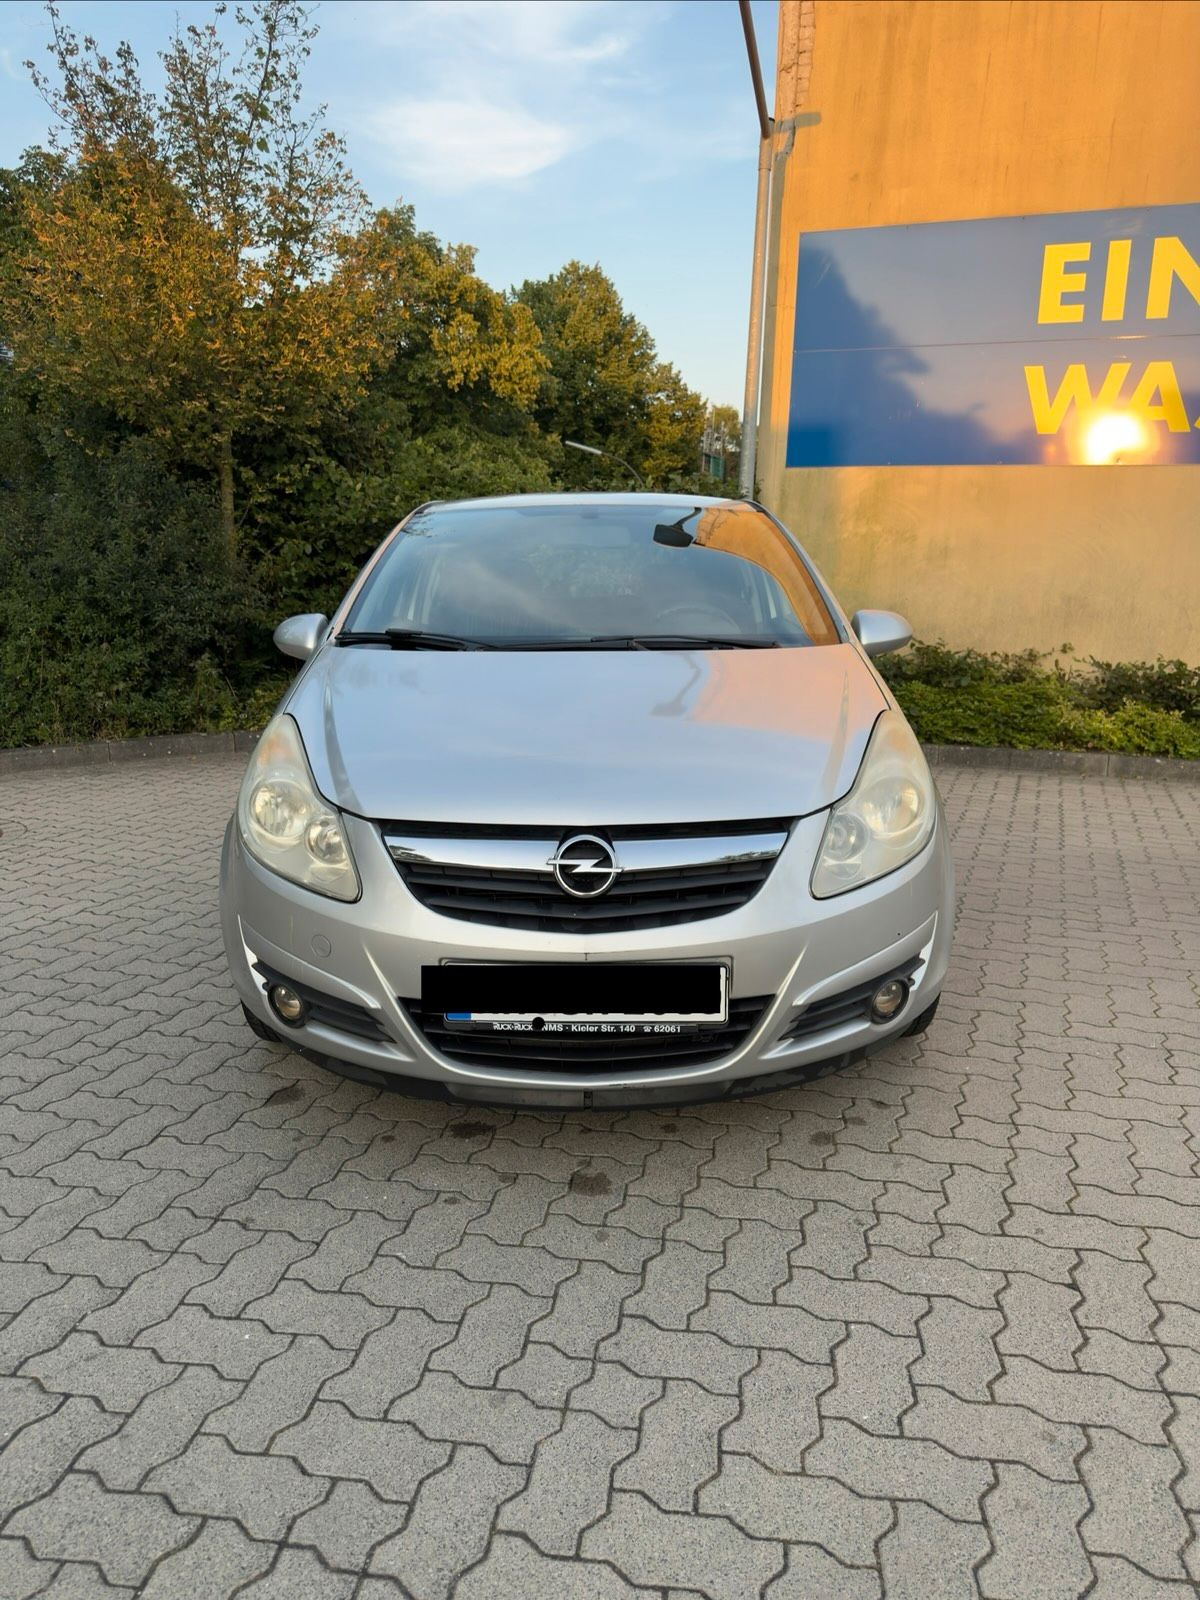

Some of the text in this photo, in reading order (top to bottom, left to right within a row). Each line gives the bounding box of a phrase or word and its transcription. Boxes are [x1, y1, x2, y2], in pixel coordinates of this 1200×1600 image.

[1024, 361, 1200, 435] WA
[571, 1024, 599, 1032] Kieler
[601, 1024, 617, 1033] Str.
[620, 1025, 636, 1033] 140
[654, 1025, 681, 1033] 62061
